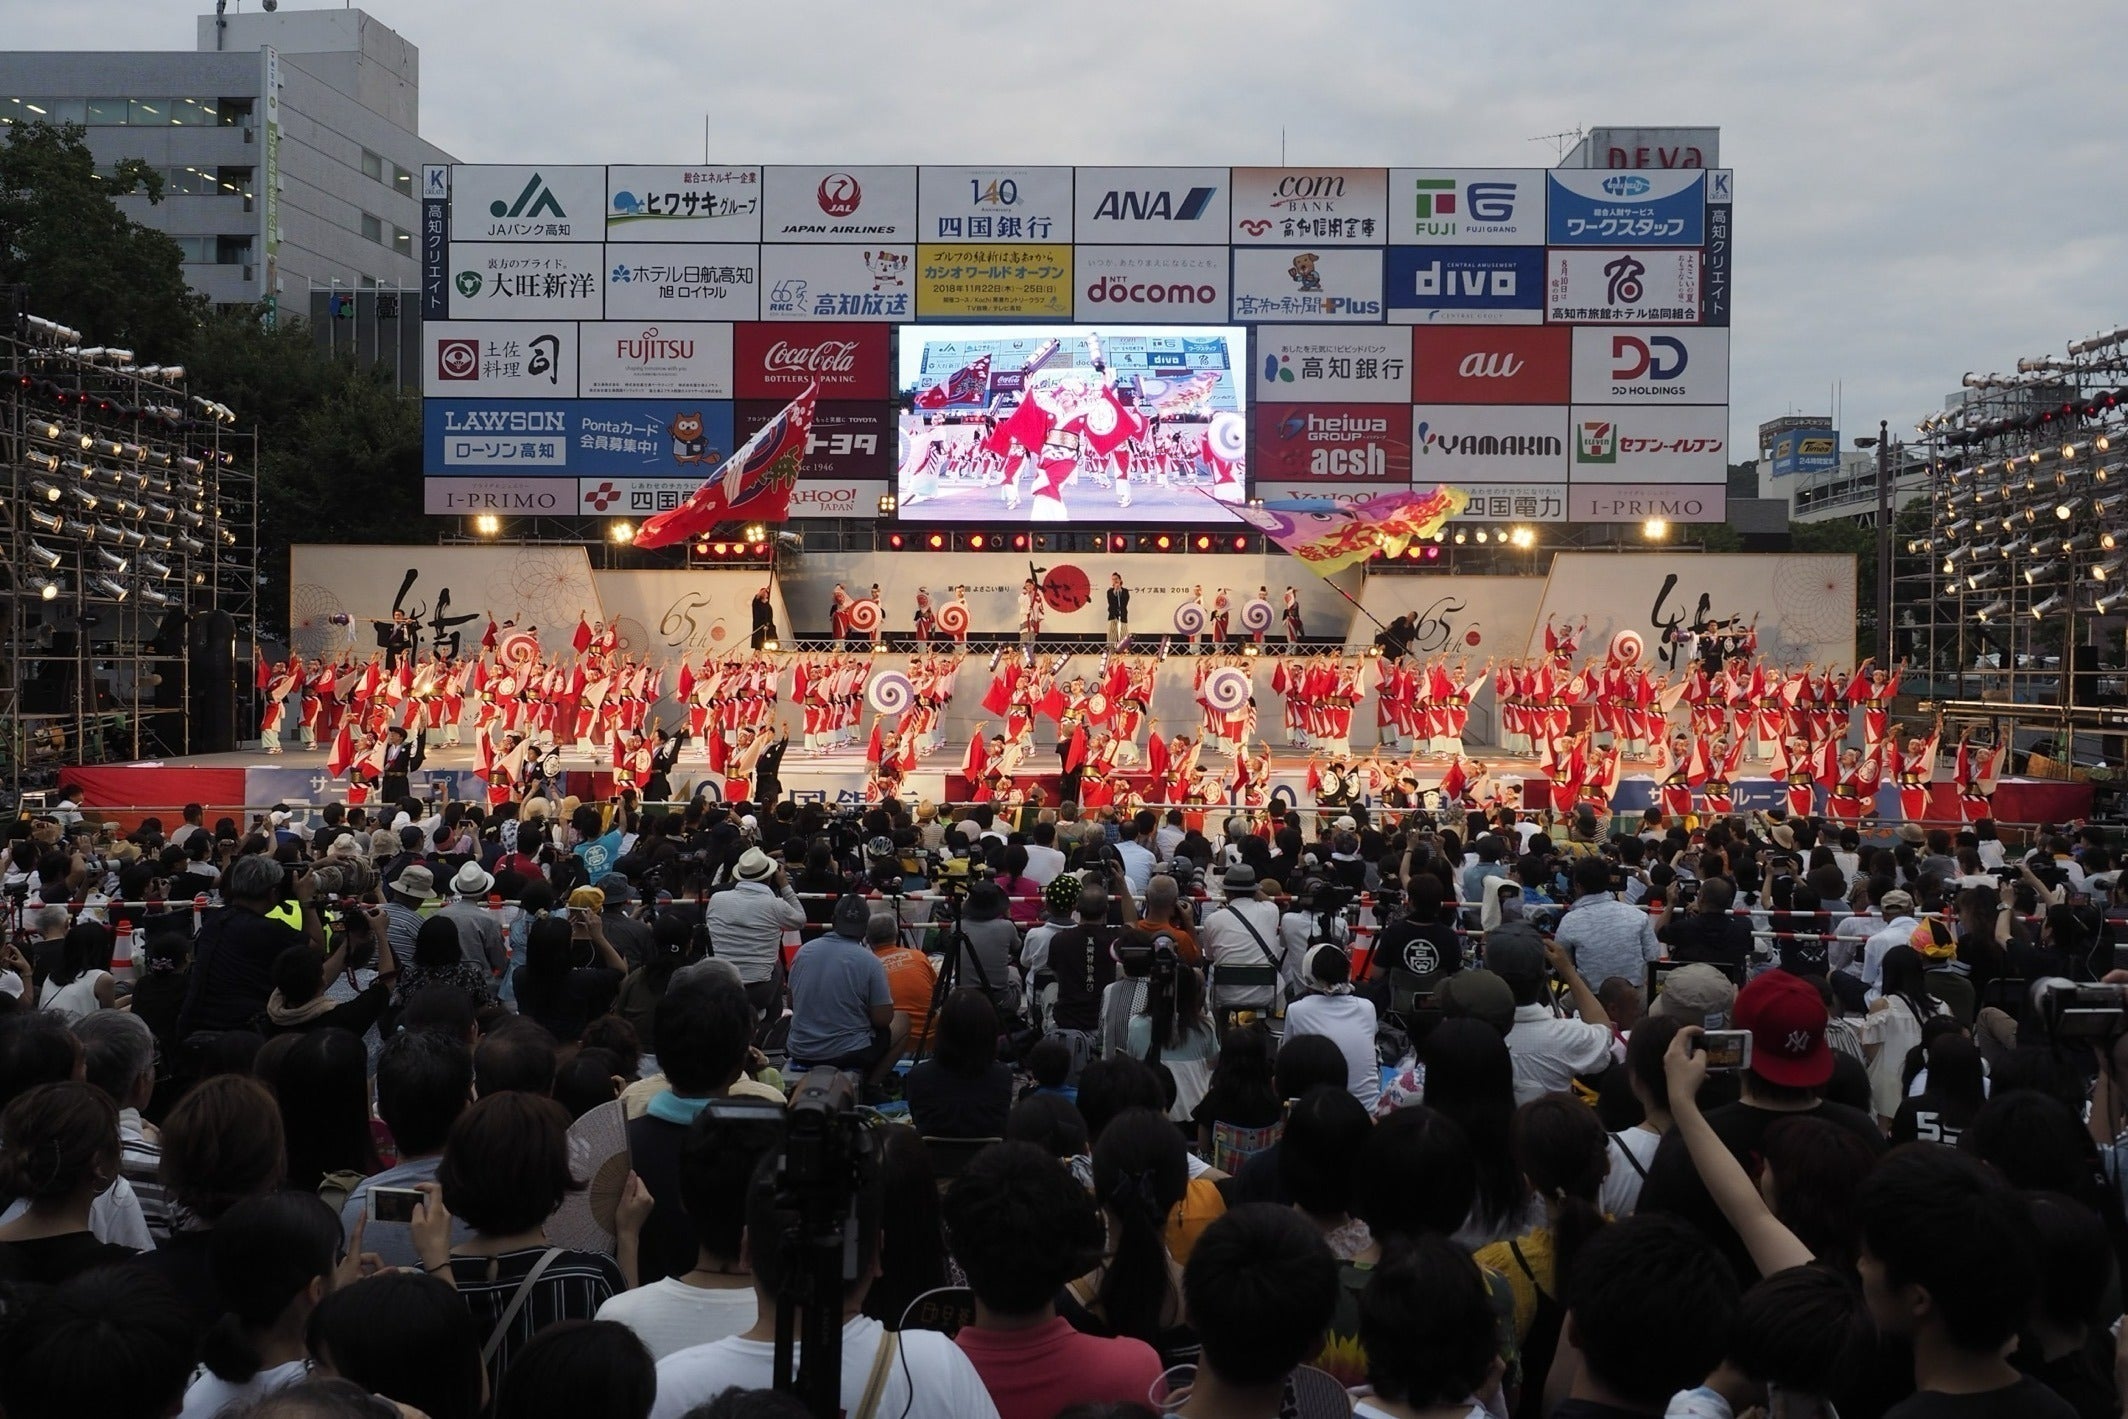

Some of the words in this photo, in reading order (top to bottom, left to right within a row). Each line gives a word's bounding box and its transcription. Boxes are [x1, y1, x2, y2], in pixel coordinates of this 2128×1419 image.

[683, 172, 757, 184] 総合エネルギー企業
[828, 203, 854, 213] JAL
[1093, 191, 1172, 220] ANA
[1290, 201, 1335, 212] BANK
[488, 223, 571, 237] JAバンク高知
[780, 225, 827, 235] JAPAN
[829, 225, 896, 235] AIRLINES
[938, 216, 1052, 239] 四国銀行
[1280, 217, 1377, 238] 高知信用金庫
[1416, 222, 1456, 236] FUJI
[1567, 219, 1684, 236] ワークスタッフ
[428, 204, 442, 309] 高知クリエイト
[1711, 210, 1725, 316] 高知クリエイト
[633, 266, 753, 284] ホテル日航高知
[1416, 260, 1517, 296] divo
[489, 272, 595, 299] 大旺新洋
[1087, 276, 1217, 304] docomo
[770, 303, 793, 311] RKC
[813, 292, 909, 316] 高知放送
[1552, 307, 1696, 321] 高知市旅館ホテル協同組合
[483, 341, 522, 358] 土佐
[617, 327, 695, 366] FUJITSU
[482, 360, 521, 379] 料理
[1302, 357, 1405, 380] 高知銀行
[1458, 352, 1524, 377] au
[764, 375, 809, 383] BOTTLERS
[840, 375, 857, 383] INC.
[1629, 386, 1685, 395] HOLDINGS
[444, 412, 566, 431] LAWSON
[582, 417, 659, 437] Pontaカード
[1309, 413, 1387, 432] heiwa
[1308, 432, 1362, 441] GROUP
[1437, 435, 1561, 456] YAMAKIN
[456, 442, 556, 459] ローソン高知
[1311, 443, 1386, 476] acsh
[813, 463, 834, 472] 1946
[446, 492, 556, 509] I-PRIMO
[819, 503, 854, 512] JAPAN
[1463, 496, 1561, 518] 四国電力
[1592, 500, 1703, 516] I-PRIMO
